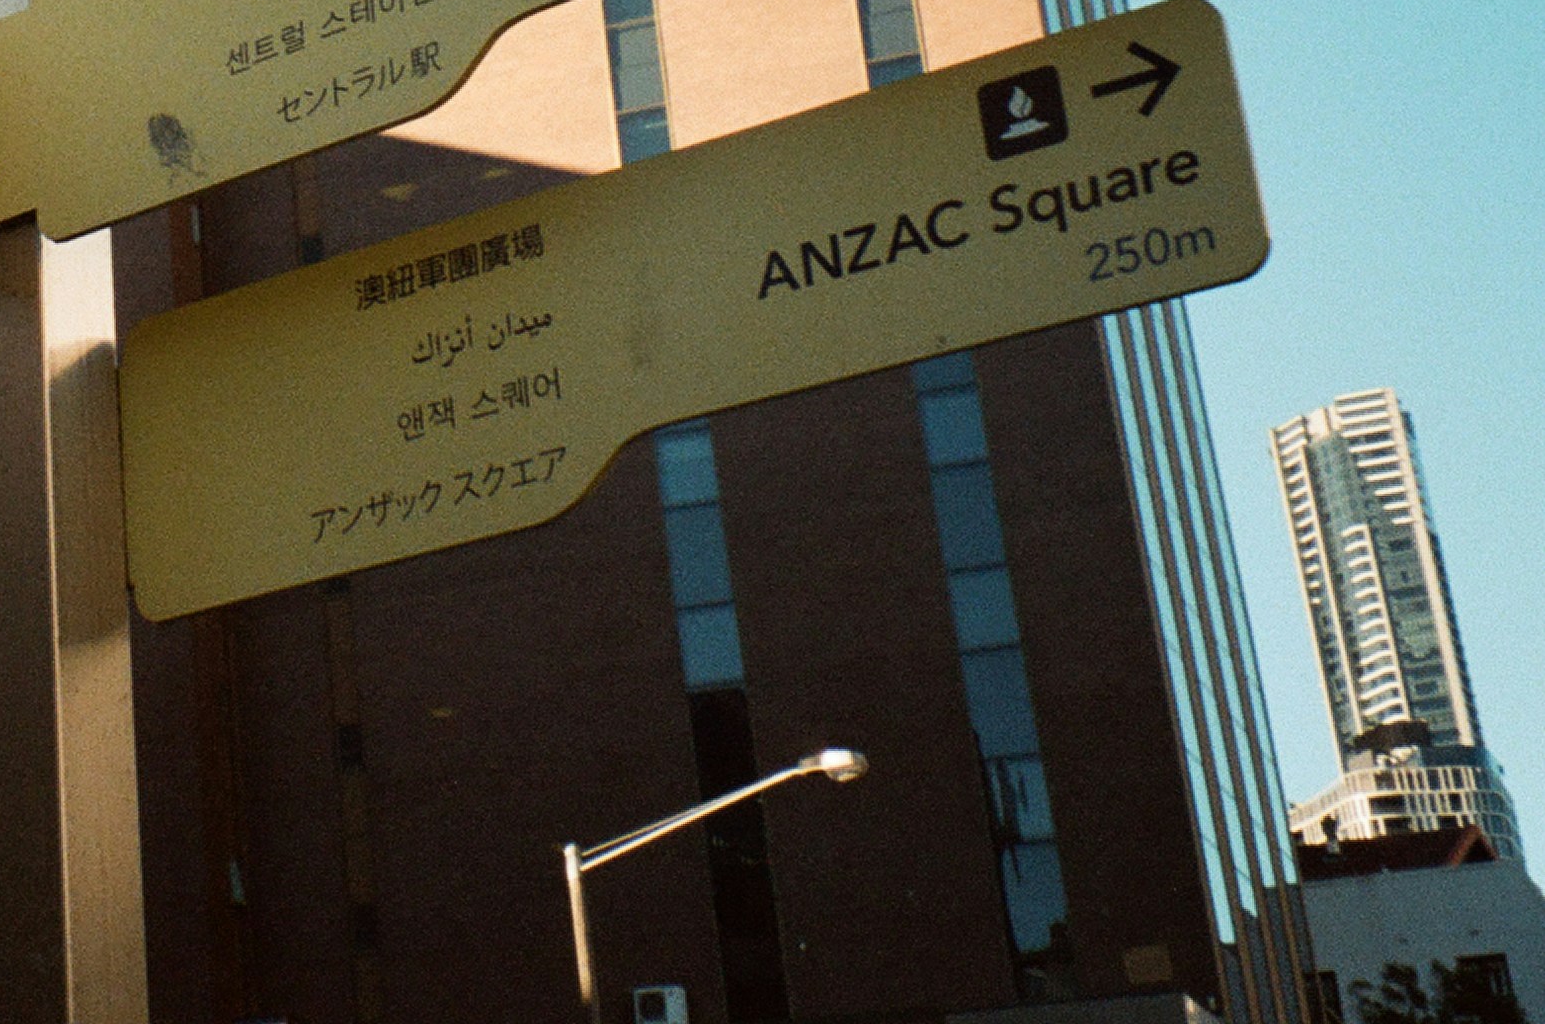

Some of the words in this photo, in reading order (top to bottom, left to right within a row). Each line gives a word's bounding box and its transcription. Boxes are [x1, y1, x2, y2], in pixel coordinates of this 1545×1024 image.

[226, 20, 305, 76] 센트럴
[758, 200, 969, 300] ANZAC
[990, 150, 1199, 233] Square
[1086, 226, 1215, 282] 250m
[488, 313, 553, 350] ميدان
[397, 395, 456, 441] 앤잭
[470, 367, 561, 419] 스퀘어
